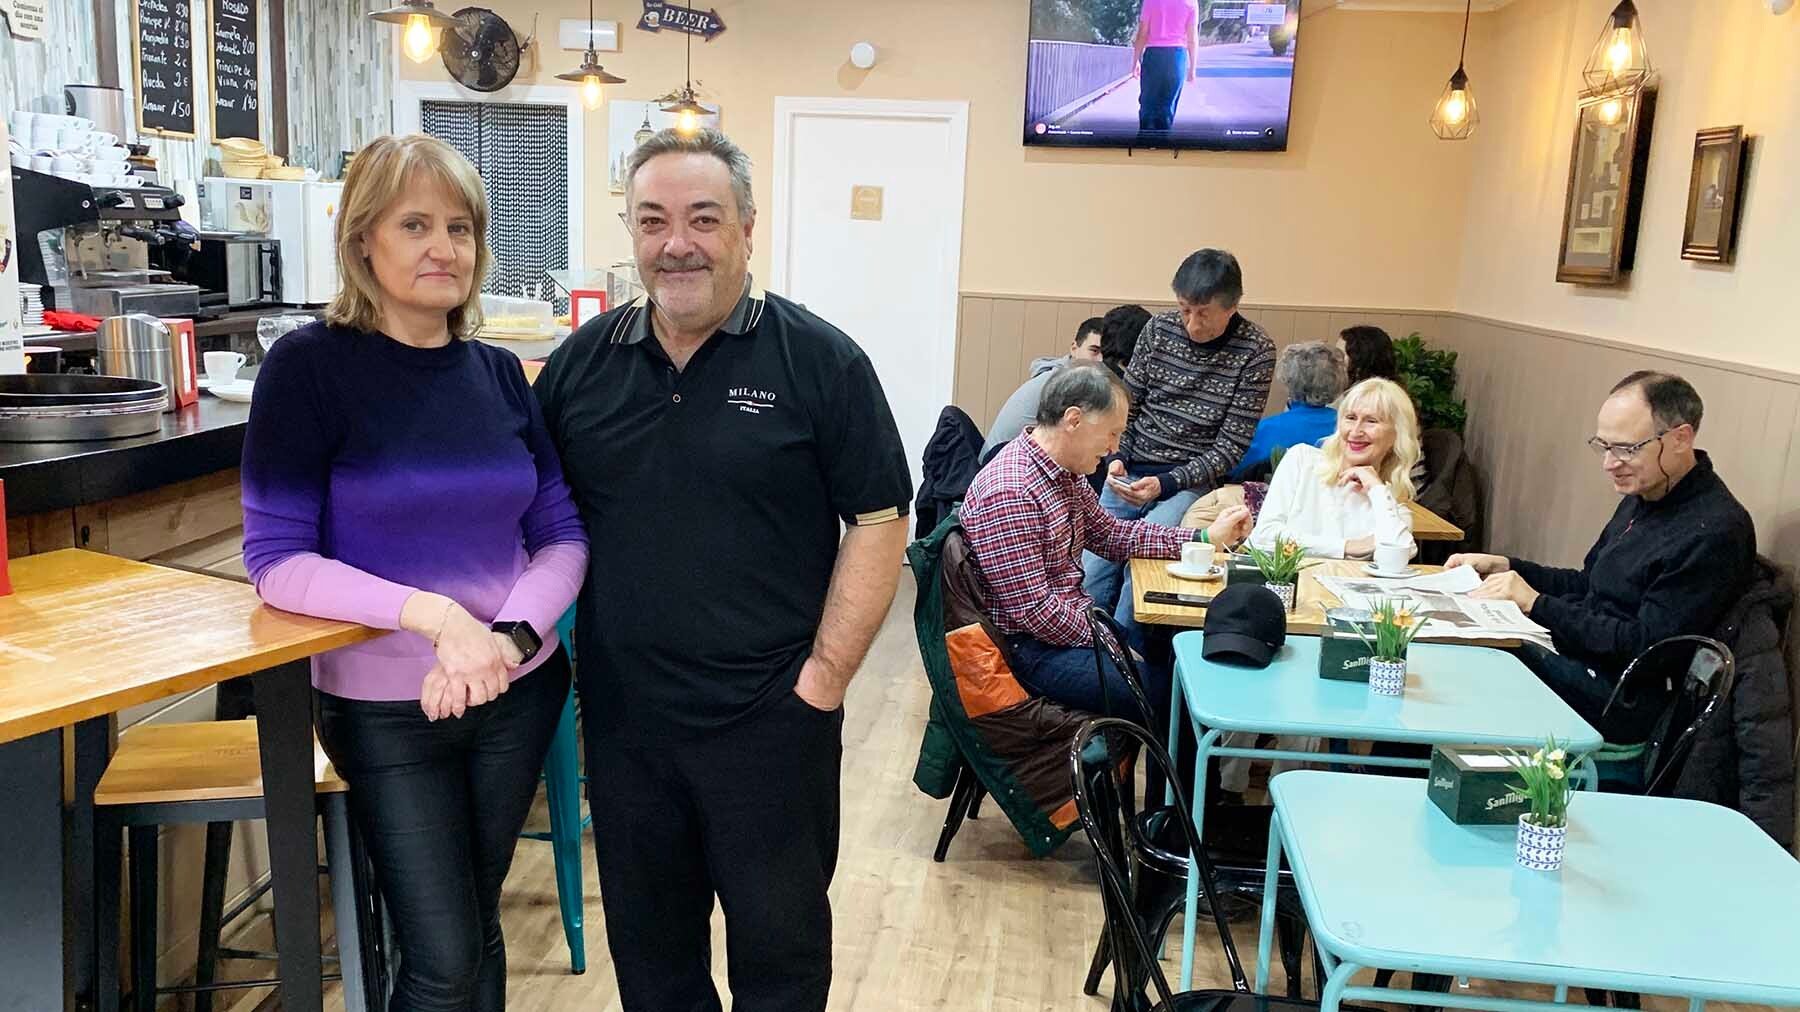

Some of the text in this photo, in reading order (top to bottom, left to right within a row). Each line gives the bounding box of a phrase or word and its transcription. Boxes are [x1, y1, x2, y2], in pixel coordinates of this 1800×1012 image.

[662, 8, 709, 30] BEER
[142, 68, 166, 89] Rueda
[728, 387, 776, 401] MILANO
[739, 405, 760, 414] ITALIA
